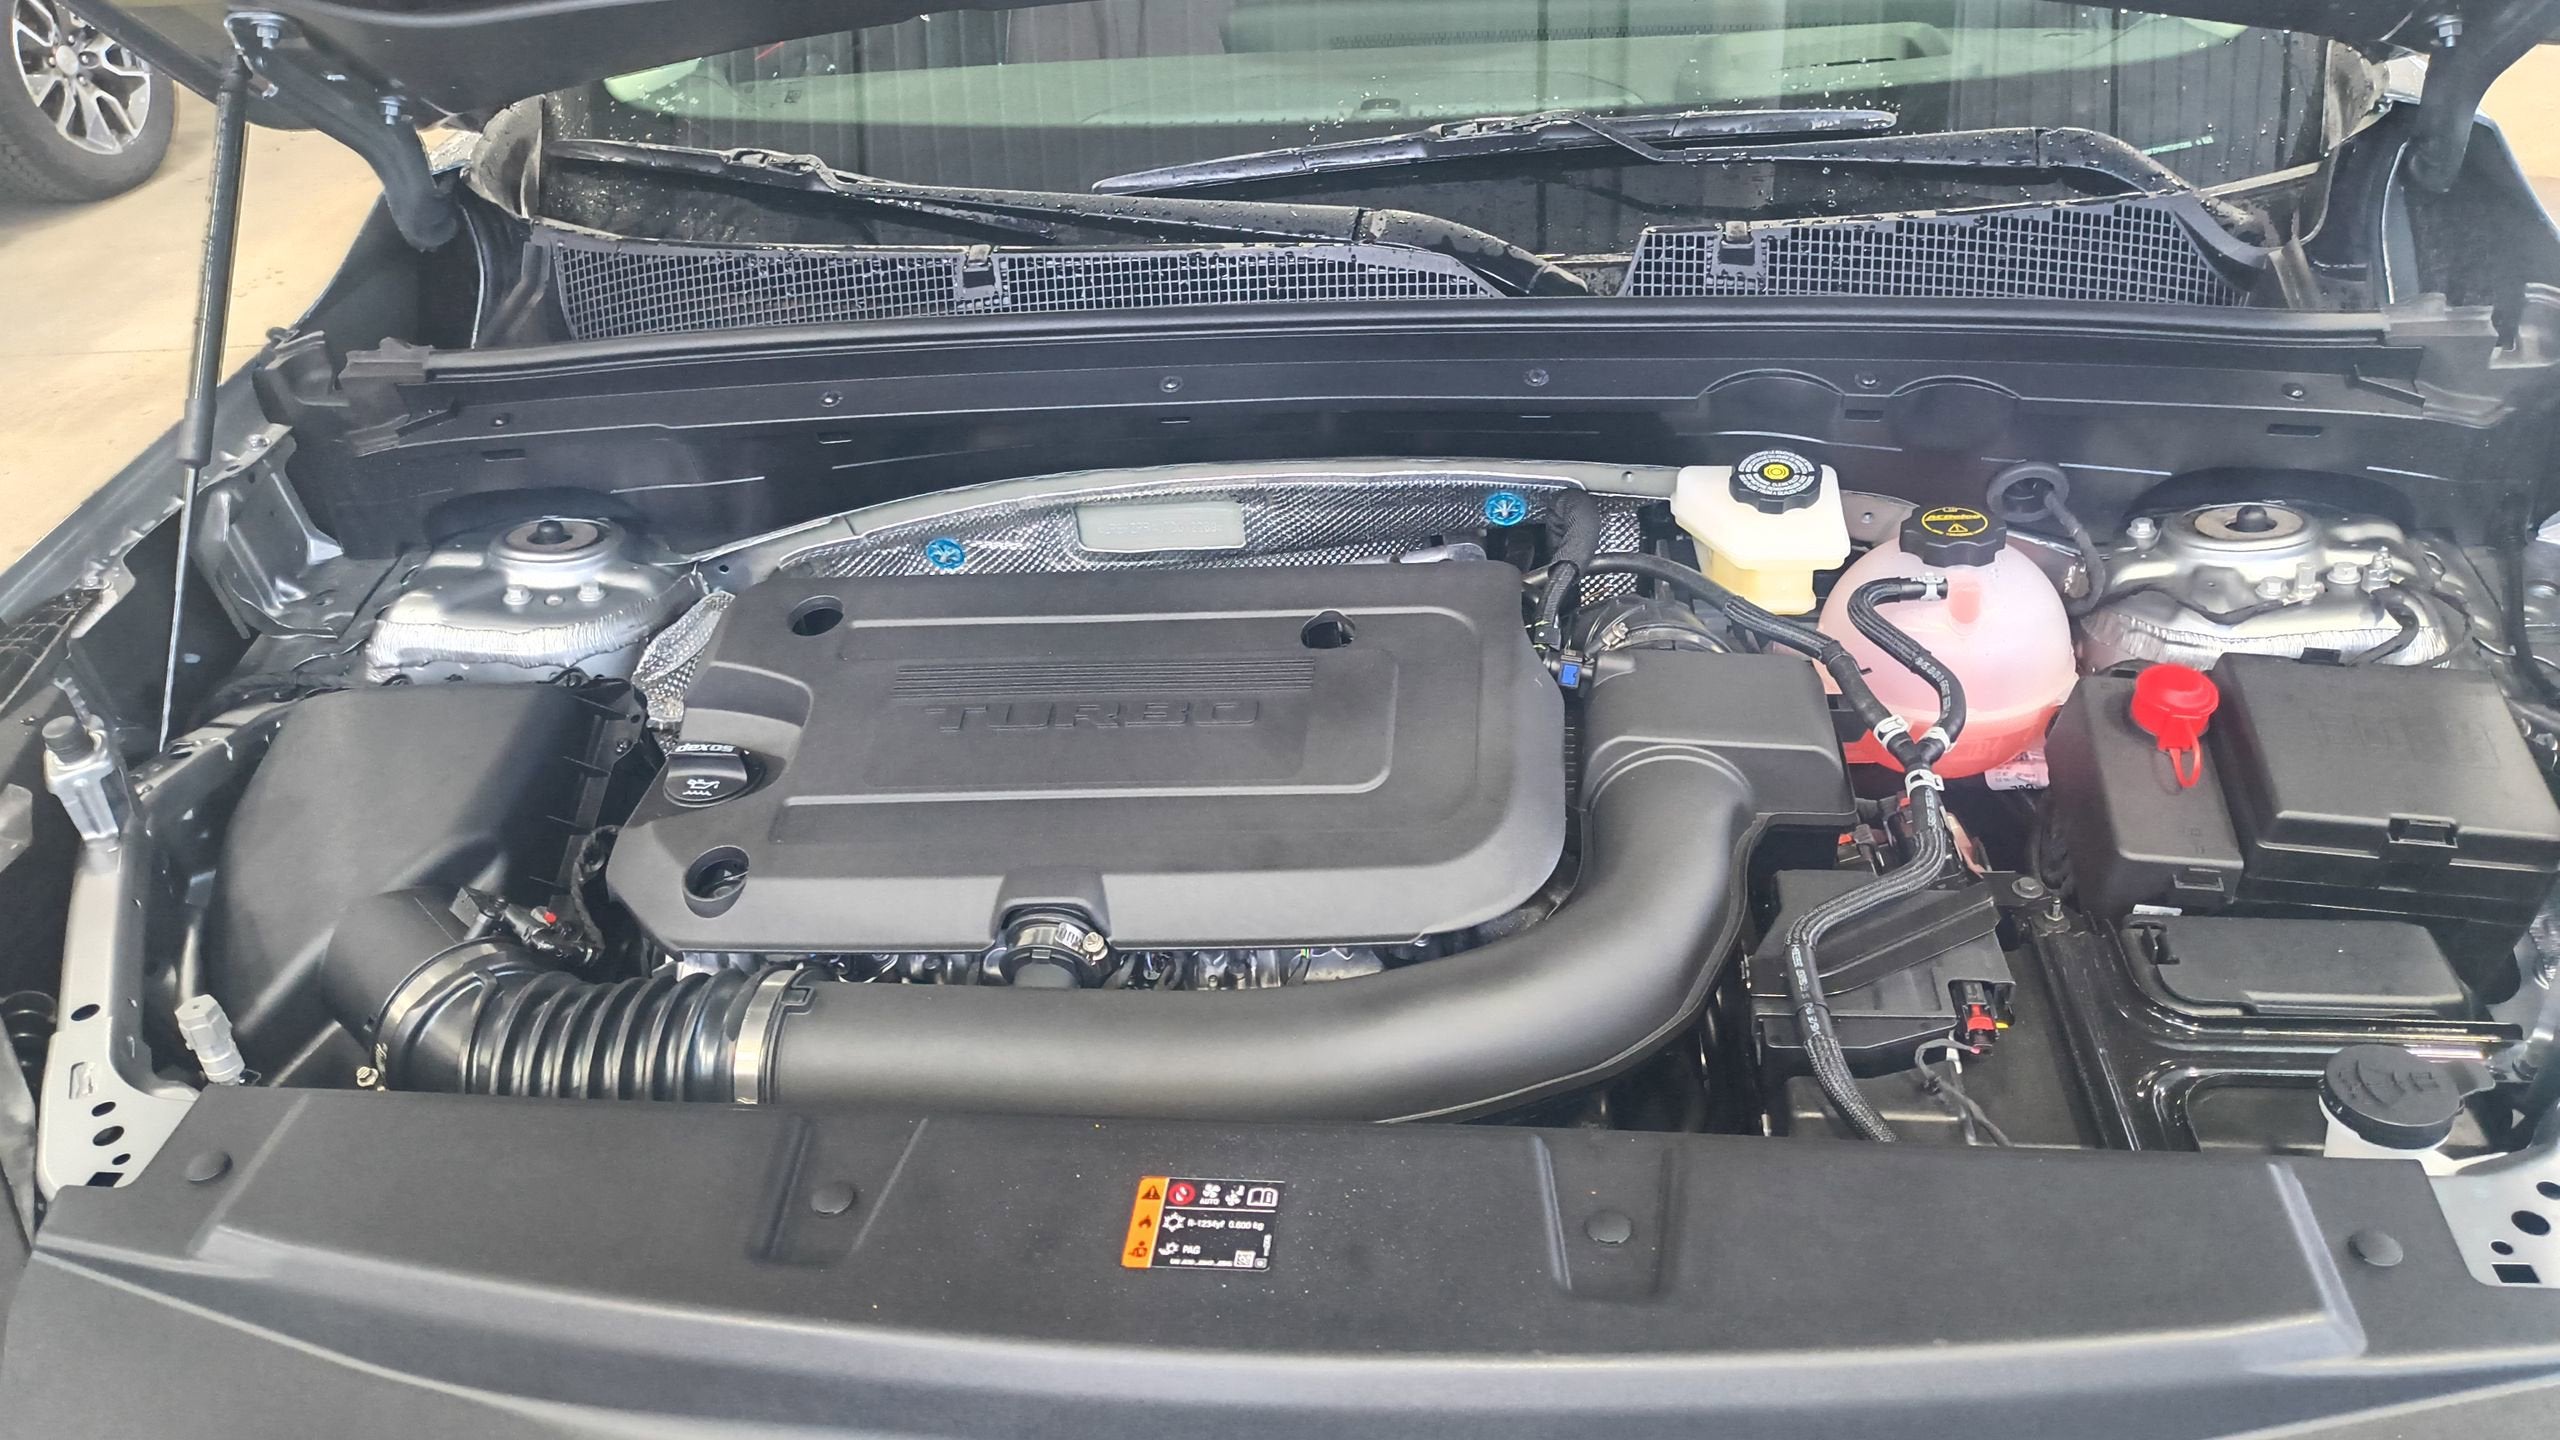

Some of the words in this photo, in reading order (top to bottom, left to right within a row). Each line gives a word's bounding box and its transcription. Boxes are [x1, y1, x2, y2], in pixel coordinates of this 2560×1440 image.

[924, 700, 1261, 732] TURBO
[675, 743, 736, 753] dexos
[1182, 1245, 1201, 1255] PAG
